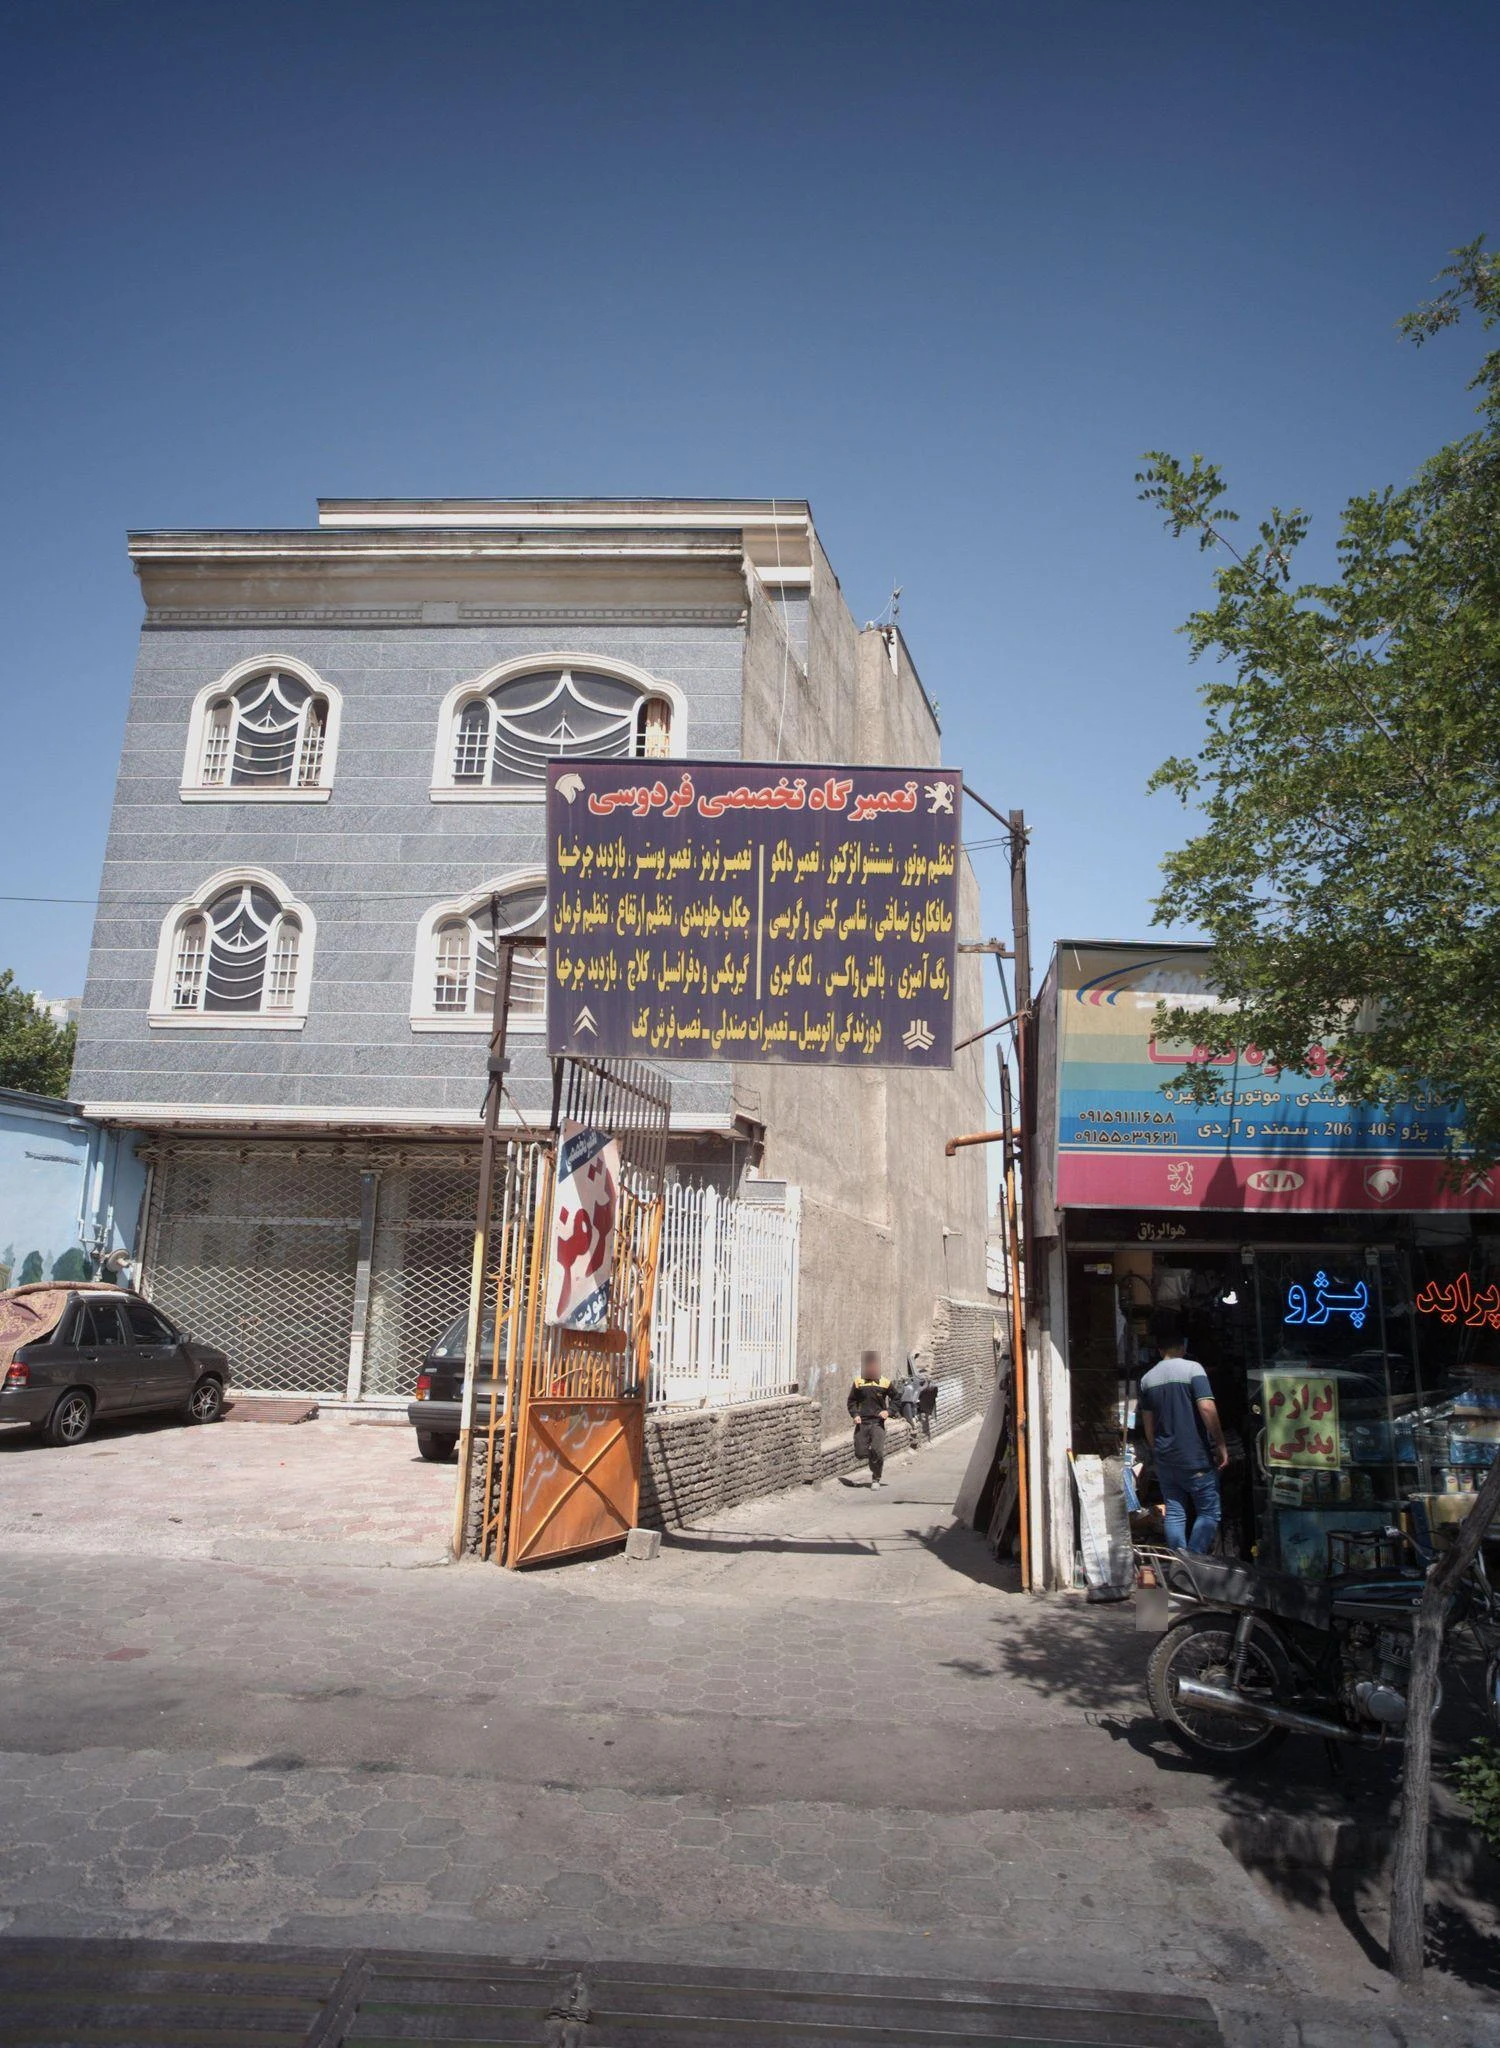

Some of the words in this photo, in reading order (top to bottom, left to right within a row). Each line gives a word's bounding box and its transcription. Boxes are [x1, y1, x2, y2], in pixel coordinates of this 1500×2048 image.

[588, 773, 696, 818] فردوسی
[697, 777, 805, 818] تخصصی
[557, 833, 594, 879] چرخها
[595, 835, 626, 879] بازدید
[633, 841, 666, 881] بوستر
[666, 838, 692, 880] تعمیر
[698, 838, 720, 882] ترمز
[720, 839, 753, 882] تعمیر
[794, 841, 819, 884] تعمیر
[827, 840, 861, 885] انژکتور
[861, 842, 894, 885] شستشو
[901, 844, 926, 886] موتور
[928, 842, 955, 886] تنظیم
[554, 889, 582, 935] فرمان
[582, 891, 609, 935] تنظیم
[616, 893, 645, 936] ارتفاع
[646, 893, 673, 936] تنظیم
[679, 894, 721, 939] جلوبندی
[722, 895, 750, 940] چکاپ
[769, 897, 803, 940] گریسی
[802, 911, 810, 940] و
[813, 897, 838, 941] کشی
[838, 897, 867, 941] شاسی
[874, 896, 910, 942] ضیافتی
[910, 897, 953, 943] صافکاری
[555, 947, 586, 992] چرخها
[587, 949, 617, 992] بازدید
[626, 947, 650, 991] کلاچ
[657, 949, 700, 994] دفرانسیل
[711, 951, 750, 996] گیربکس
[769, 953, 796, 996] گیری
[796, 952, 813, 986] لکه
[825, 953, 860, 998] واکس
[861, 953, 886, 998] پالش
[898, 952, 930, 999] آمیزی
[929, 957, 950, 1000] رنگ
[631, 1007, 650, 1039] کف
[651, 1005, 677, 1049] فرش
[677, 1008, 701, 1047] نصب
[711, 1008, 747, 1050] صندلی
[748, 1008, 788, 1051] تعمیرات
[799, 1010, 835, 1052] اتومبیل
[835, 1012, 882, 1054] دوزندگی
[1079, 1110, 1176, 1124] ۰۹۱۵۹۱۱۱۶۵۸
[1220, 1089, 1282, 1107] موتوری
[1075, 1130, 1178, 1145] ۰۹۱۵۵۰۳۹۶۲۱
[1198, 1117, 1242, 1139] آردی
[1245, 1124, 1256, 1138] و
[1260, 1122, 1308, 1138] سمند
[1323, 1121, 1353, 1136] 206
[1367, 1121, 1396, 1136] 405
[1401, 1122, 1428, 1144] پژو
[1255, 1173, 1297, 1188] KIA
[1284, 1270, 1369, 1329] پژو
[1416, 1272, 1500, 1330] پراید
[1268, 1384, 1334, 1421] لوازم
[1269, 1427, 1336, 1463] یدکی
